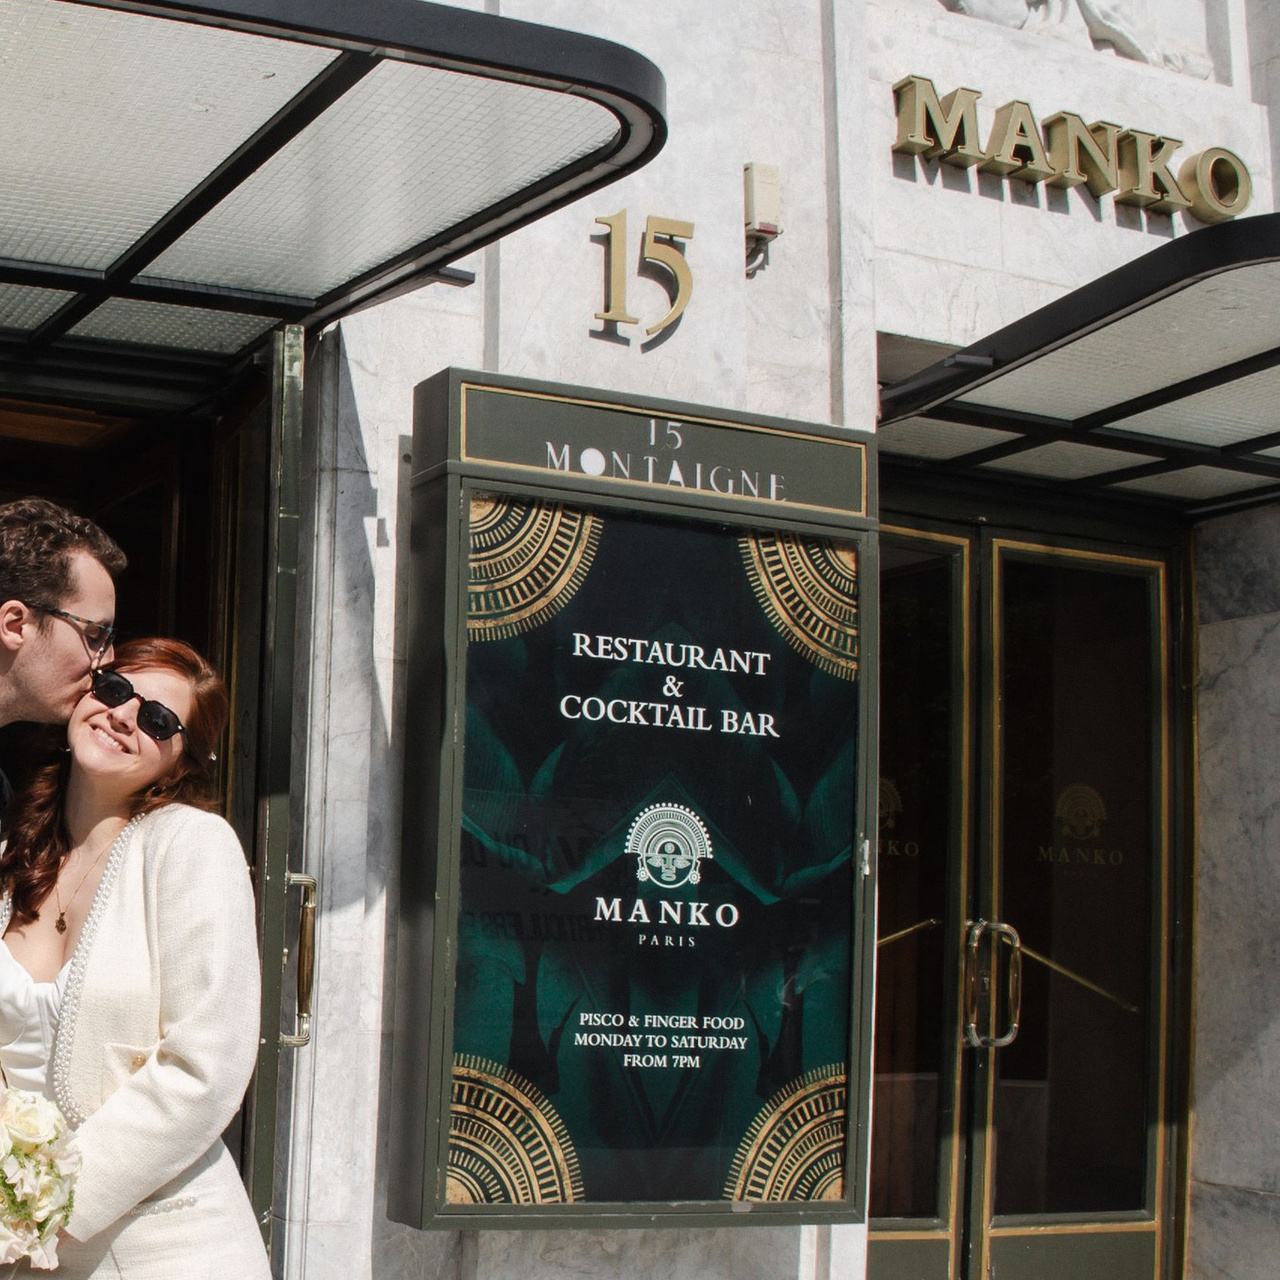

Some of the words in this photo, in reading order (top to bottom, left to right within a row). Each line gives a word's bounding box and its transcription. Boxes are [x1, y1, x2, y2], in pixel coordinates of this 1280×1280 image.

[891, 74, 1253, 224] MANKO
[594, 209, 694, 336] 15
[649, 418, 683, 450] 15
[545, 441, 787, 503] MONTAIGNE
[572, 632, 771, 676] RESTAURANT
[662, 675, 684, 698] &
[560, 694, 713, 731] COCKTAIL
[720, 709, 781, 738] BAR
[1038, 846, 1125, 866] MANKO
[593, 896, 740, 928] MANKO
[638, 933, 696, 948] PARIS
[579, 1012, 624, 1027] PISCO
[628, 1015, 640, 1027] &
[644, 1014, 699, 1029] FINGER
[702, 1016, 745, 1030] FOOD
[574, 1032, 644, 1047] MONDAY
[644, 1034, 668, 1048] TO
[670, 1035, 749, 1050] SATURDAY
[623, 1053, 668, 1068] FROM
[671, 1055, 701, 1068] 7PM
